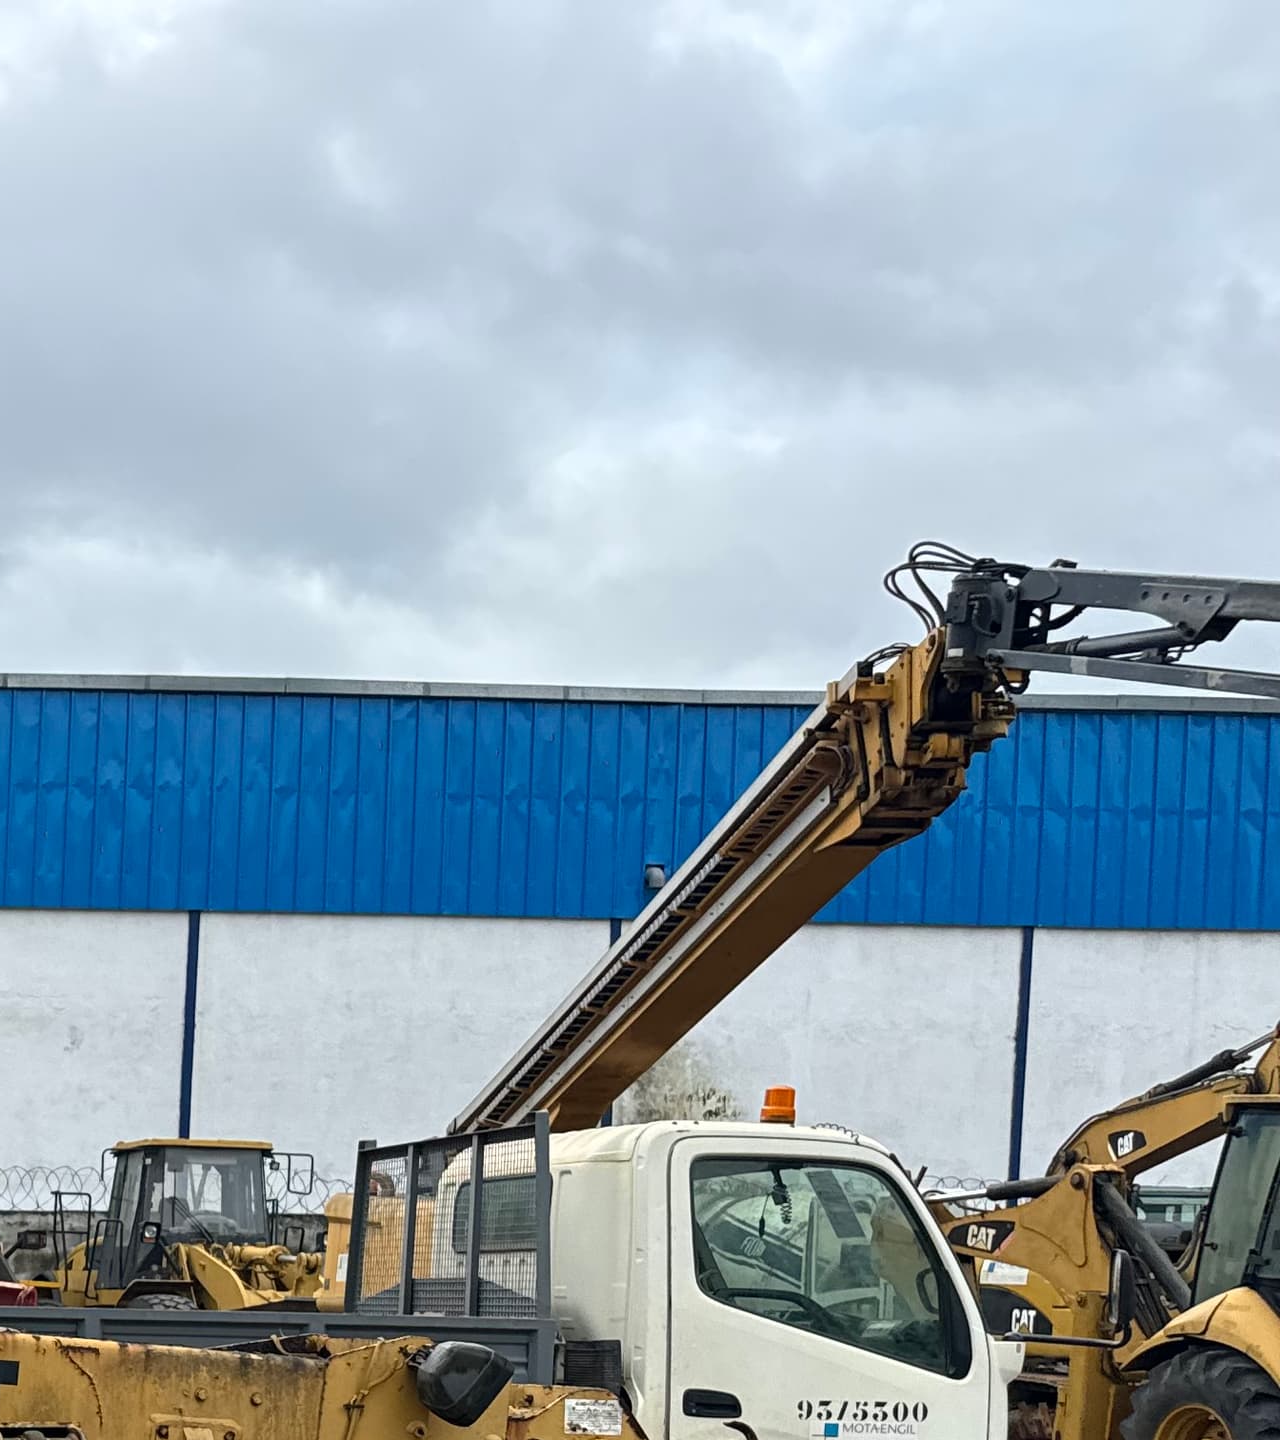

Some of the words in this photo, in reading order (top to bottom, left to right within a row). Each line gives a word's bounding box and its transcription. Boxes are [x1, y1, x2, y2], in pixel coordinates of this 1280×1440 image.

[1117, 1132, 1135, 1157] CAT
[966, 1224, 996, 1251] CAT
[1011, 1307, 1037, 1334] CAT
[797, 1399, 929, 1422] 93/5300
